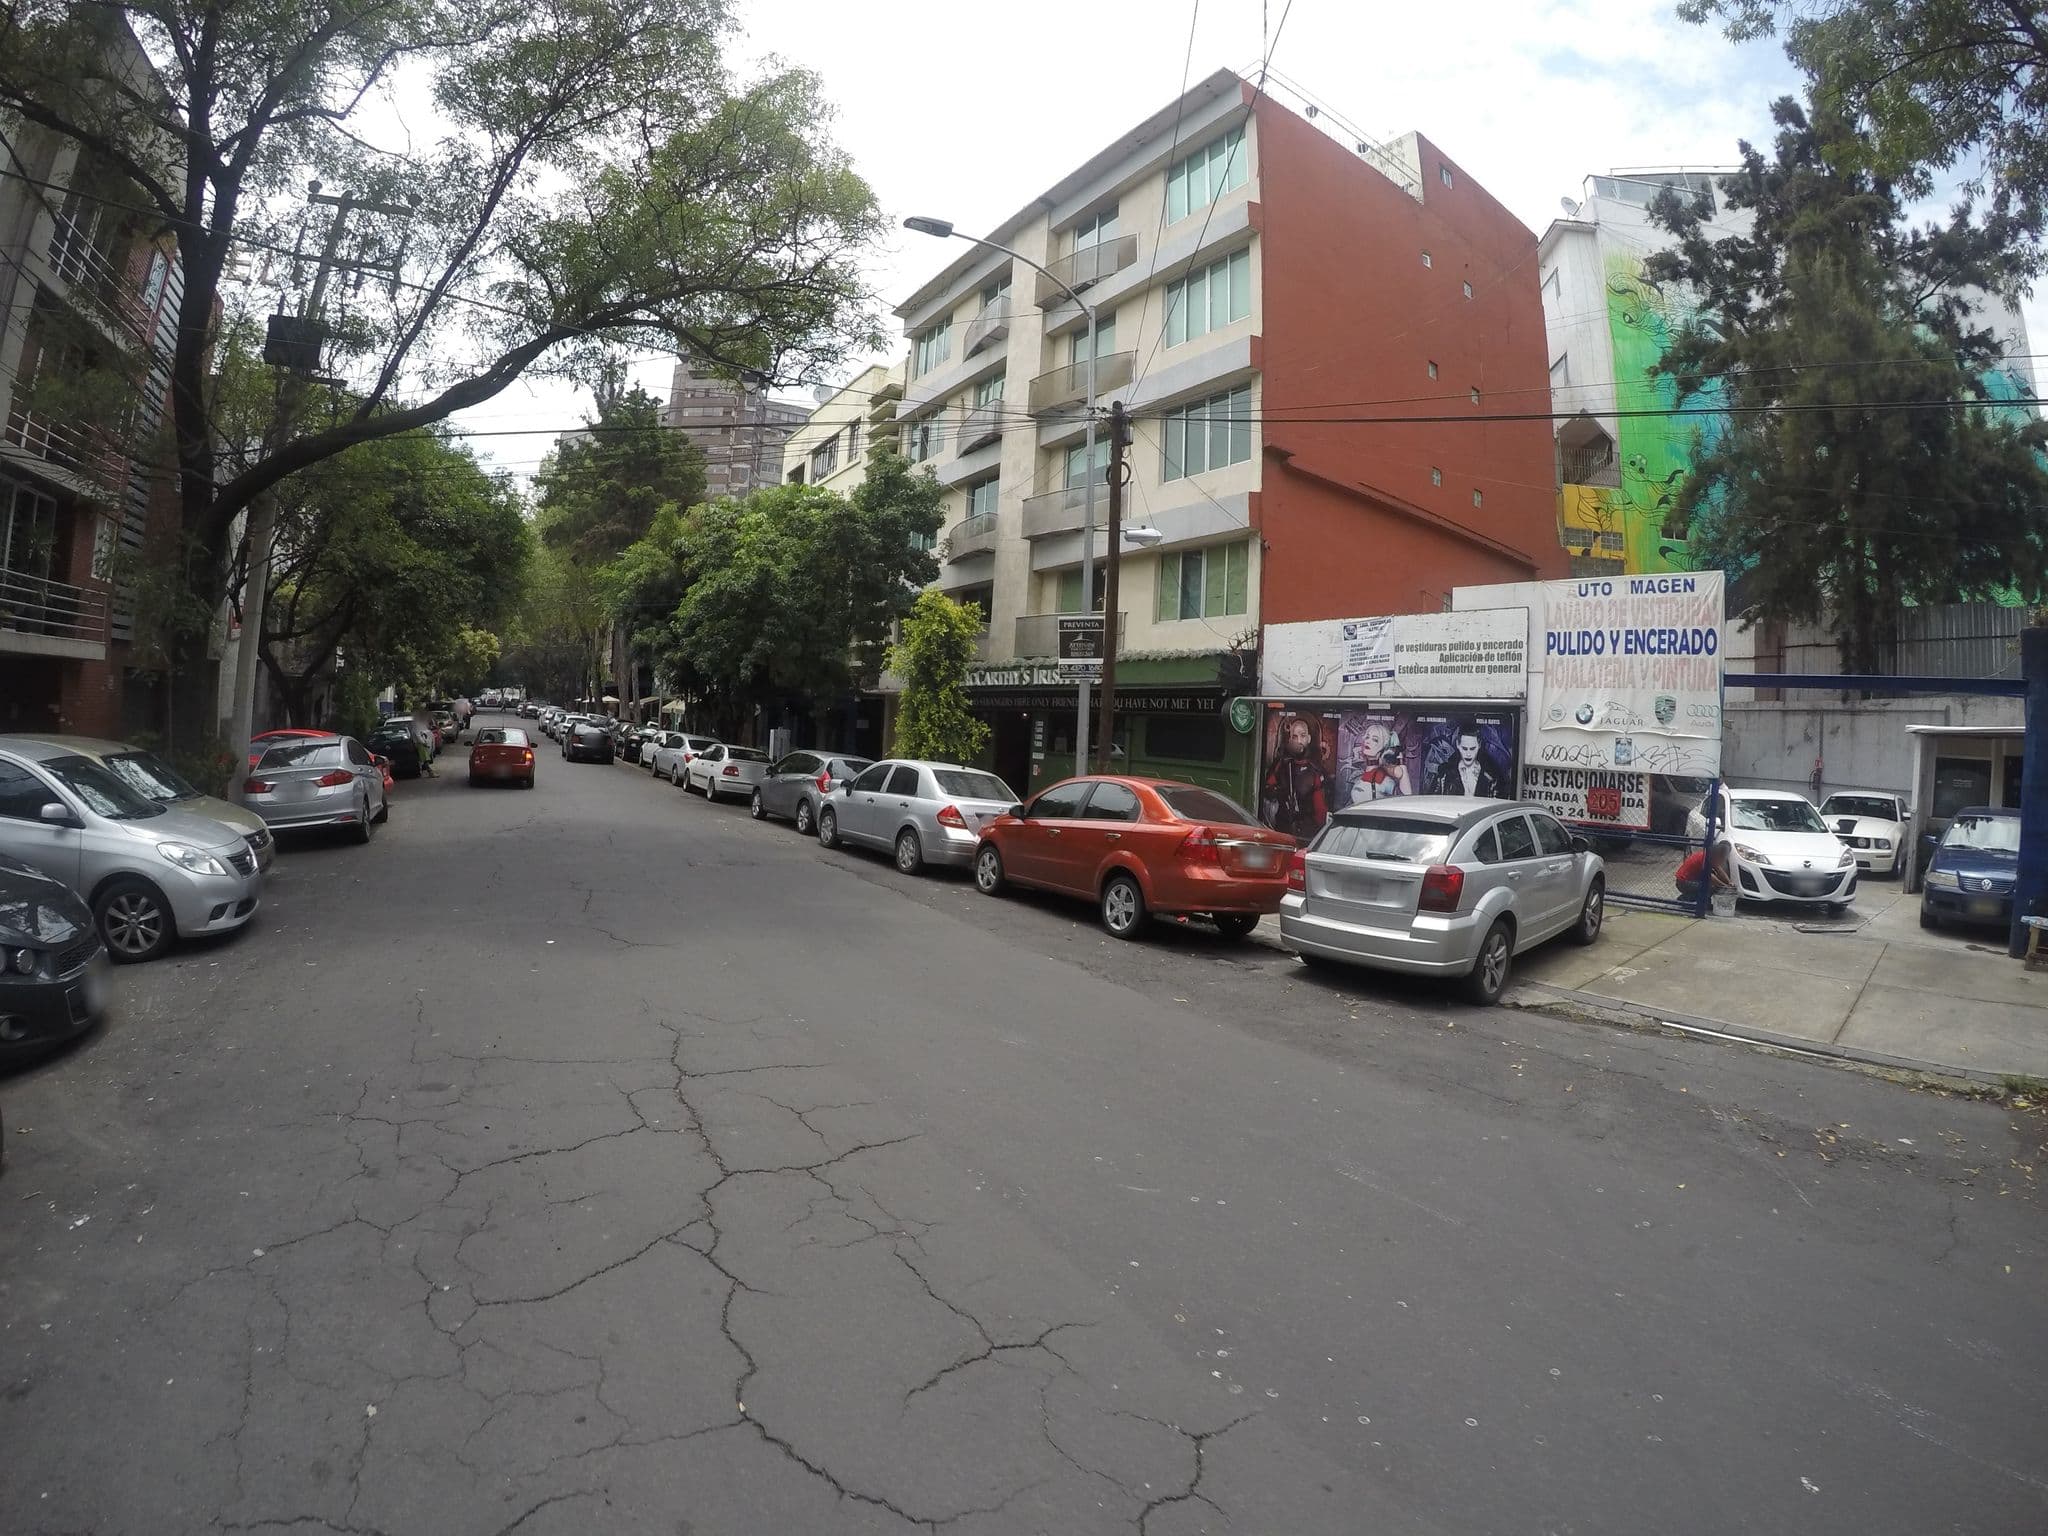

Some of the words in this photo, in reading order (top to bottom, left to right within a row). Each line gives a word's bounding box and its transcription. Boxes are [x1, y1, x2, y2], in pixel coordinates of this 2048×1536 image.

[1395, 643, 1405, 653] de
[1406, 641, 1448, 653] vestiduras
[1449, 640, 1475, 652] pulido
[1476, 642, 1482, 652] y
[1482, 639, 1524, 650] encerado
[1547, 630, 1605, 656] PULIDO
[1609, 630, 1620, 655] Y
[1624, 628, 1718, 656] ENCERADO
[1439, 651, 1483, 663] Aplicación
[1484, 652, 1495, 661] de
[1430, 664, 1474, 674] automotriz
[1475, 664, 1486, 673] en
[1487, 663, 1522, 675] general
[1125, 698, 1147, 709] HAVE
[1150, 698, 1169, 709] NOT
[1171, 698, 1190, 709] MET
[1197, 698, 1216, 710] YET
[1600, 717, 1644, 727] JAGUAR
[1523, 767, 1539, 786] NO
[1543, 768, 1644, 794] ESTACIONARSE
[1521, 789, 1579, 804] ENTRADA
[1621, 797, 1645, 809] IDA
[1591, 793, 1618, 812] 205
[1548, 805, 1564, 817] AS
[1568, 807, 1584, 818] 24
